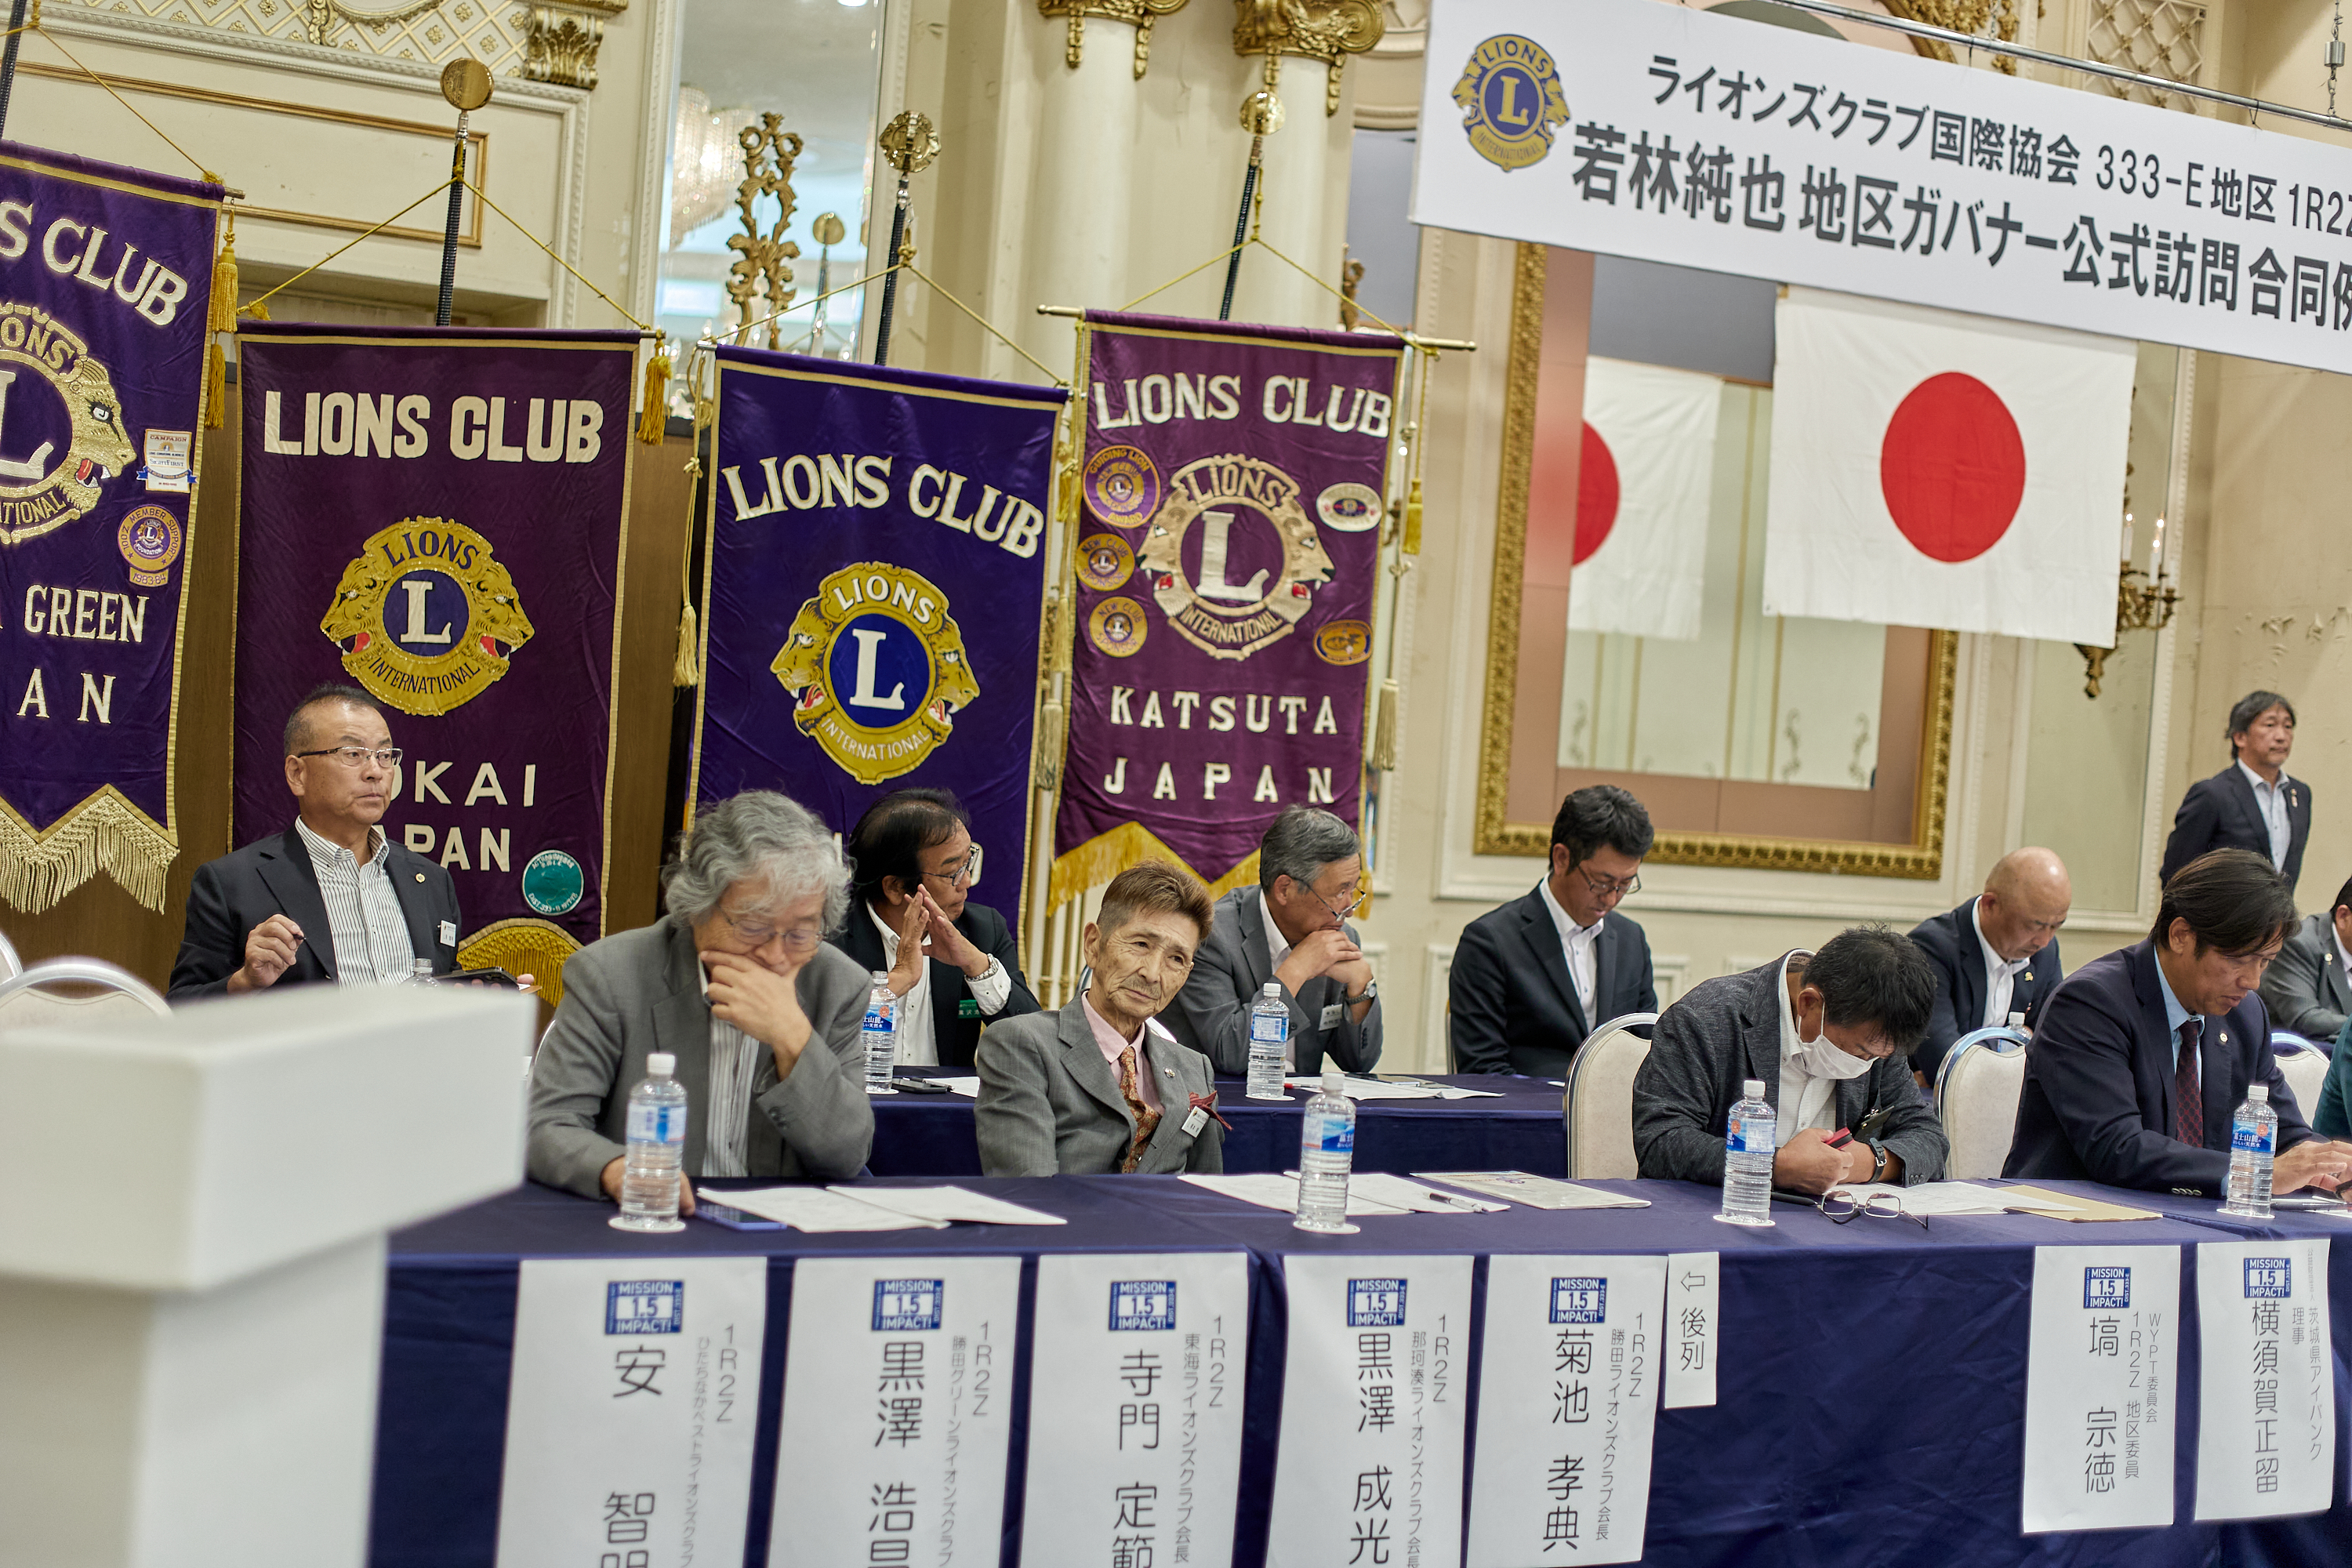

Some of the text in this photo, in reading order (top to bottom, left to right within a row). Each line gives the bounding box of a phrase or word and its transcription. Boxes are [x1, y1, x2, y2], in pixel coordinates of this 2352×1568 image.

[1483, 39, 1549, 73] LIONS
[1497, 75, 1529, 126] L
[1647, 54, 2081, 187] ライオンズクラブ国際協会
[1572, 121, 1786, 233] 若林純也
[43, 218, 187, 326] CLUB
[264, 390, 604, 463] LIONS CLUB
[1092, 372, 1392, 438] LIONS CLUB
[1089, 448, 1151, 474] GUIDING LION
[0, 491, 67, 524] TIONAL
[721, 453, 1045, 558] LIONS CLUB
[1186, 465, 1287, 510] LIONS
[129, 508, 166, 523] MEMBER
[167, 519, 179, 560] SUPPORT
[147, 526, 154, 539] L
[381, 530, 481, 571] LIONS
[1081, 538, 1129, 557] NEW CLUB
[1196, 510, 1270, 602] L
[24, 584, 150, 643] GREEN
[400, 580, 452, 644] L
[833, 575, 935, 624] LIONS
[1098, 602, 1143, 623] NEW CLUB
[1096, 633, 1138, 652] SPONSOR
[1181, 603, 1284, 644] INTERNATIONAL
[368, 656, 481, 695] INTERNATIONAL
[849, 628, 906, 710] L
[1109, 685, 1338, 735] KATSUTA
[821, 717, 931, 762] INTERNATIONAL
[390, 760, 536, 808] KAI
[1103, 757, 1334, 804] JAPAN
[372, 824, 510, 873] PAN
[619, 1281, 673, 1294] MISSION
[885, 1279, 934, 1292] MISSION
[1356, 1279, 1399, 1291] MISSION
[1559, 1279, 1599, 1290] MISSION
[2091, 1268, 2125, 1278] MISSION
[2099, 1279, 2115, 1296] 1.5
[2249, 1259, 2285, 1269] MISSION
[2258, 1270, 2276, 1286] 1.5
[633, 1296, 659, 1317] 1.5
[897, 1294, 920, 1314] 1.5
[1120, 1282, 1167, 1294] MISSION
[1131, 1295, 1154, 1315] 1.5
[1367, 1293, 1387, 1311] 1.5
[1569, 1291, 1588, 1309] 1.5
[2090, 1297, 2123, 1308] IMPACT!
[2249, 1287, 2285, 1298] IMPACT!
[616, 1319, 672, 1334] IMPACT!
[882, 1316, 931, 1330] IMPACT!
[1118, 1316, 1166, 1329] IMPACT!
[1355, 1313, 1397, 1325] IMPACT!
[1557, 1311, 1597, 1322] IMPACT!
[1680, 1307, 1706, 1371] 後列
[2291, 1307, 2306, 1345] 理事
[612, 1344, 666, 1399] 安
[717, 1323, 738, 1422] 1R2Z
[973, 1320, 992, 1417] 1R2Z
[1209, 1315, 1225, 1407] 1R2Z
[1432, 1314, 1450, 1403] 1R2Z
[1629, 1312, 1645, 1397] 1R2Z
[2146, 1313, 2161, 1423] WYPT委員会
[875, 1341, 925, 1448] 黒澤
[1120, 1348, 1163, 1450] 寺門
[2085, 1316, 2120, 1494] 塙 宗徳
[2125, 1311, 2141, 1479] 1R2Z 地区委員
[2252, 1300, 2281, 1494] 横須賀正留
[2308, 1307, 2322, 1461] 茨城県アイバンク
[1174, 1333, 1200, 1564] 東海ライオンズクラブ会長
[1348, 1333, 1395, 1566] 黒澤 成光
[1543, 1328, 1594, 1552] 菊池 孝典
[1595, 1328, 1624, 1541] 勝田ライオンズクラブ会長
